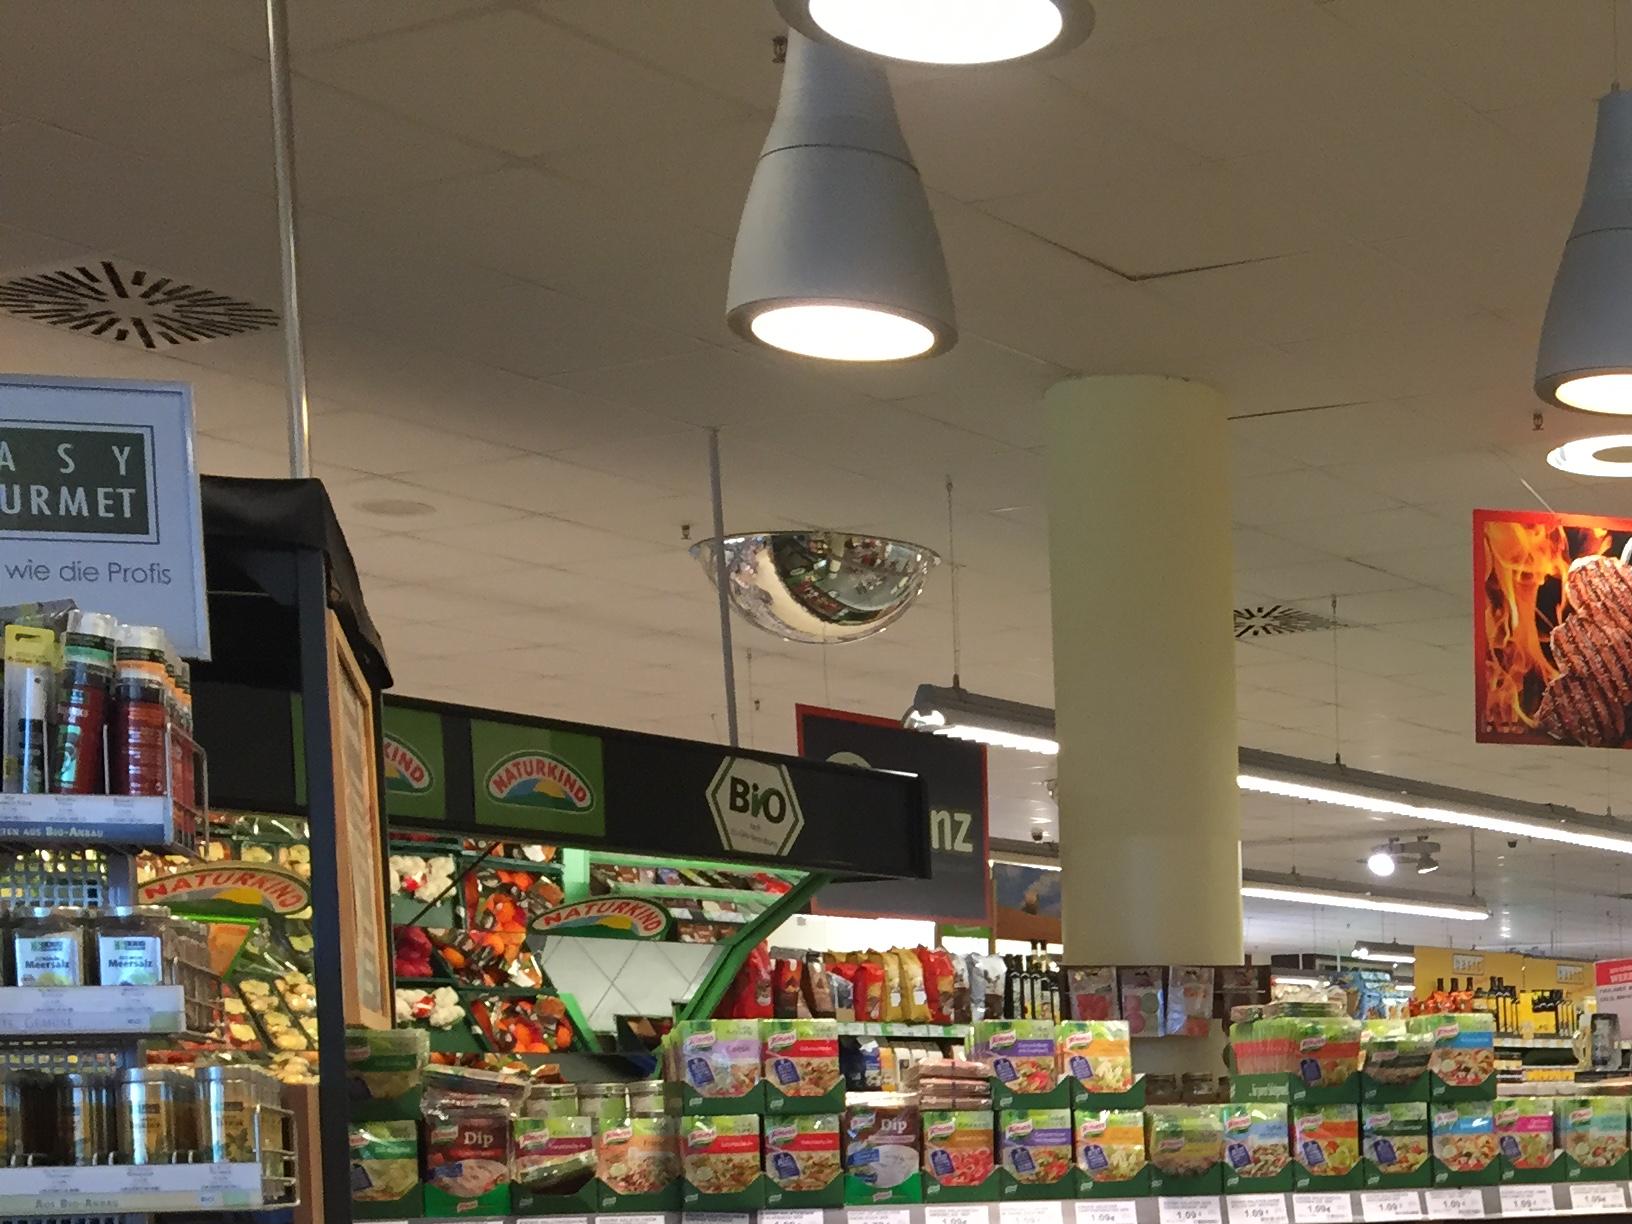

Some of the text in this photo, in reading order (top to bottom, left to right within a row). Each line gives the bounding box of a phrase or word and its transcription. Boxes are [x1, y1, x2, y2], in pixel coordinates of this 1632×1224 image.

[5, 559, 172, 585] wie die Profis
[492, 758, 587, 803] NATURKIND
[144, 870, 301, 910] NATURKIND
[543, 901, 662, 933] NATURKIND
[25, 960, 70, 969] Meersalz
[108, 959, 153, 968] Meersalz
[881, 1118, 908, 1133] Dip
[463, 1130, 494, 1148] Dip
